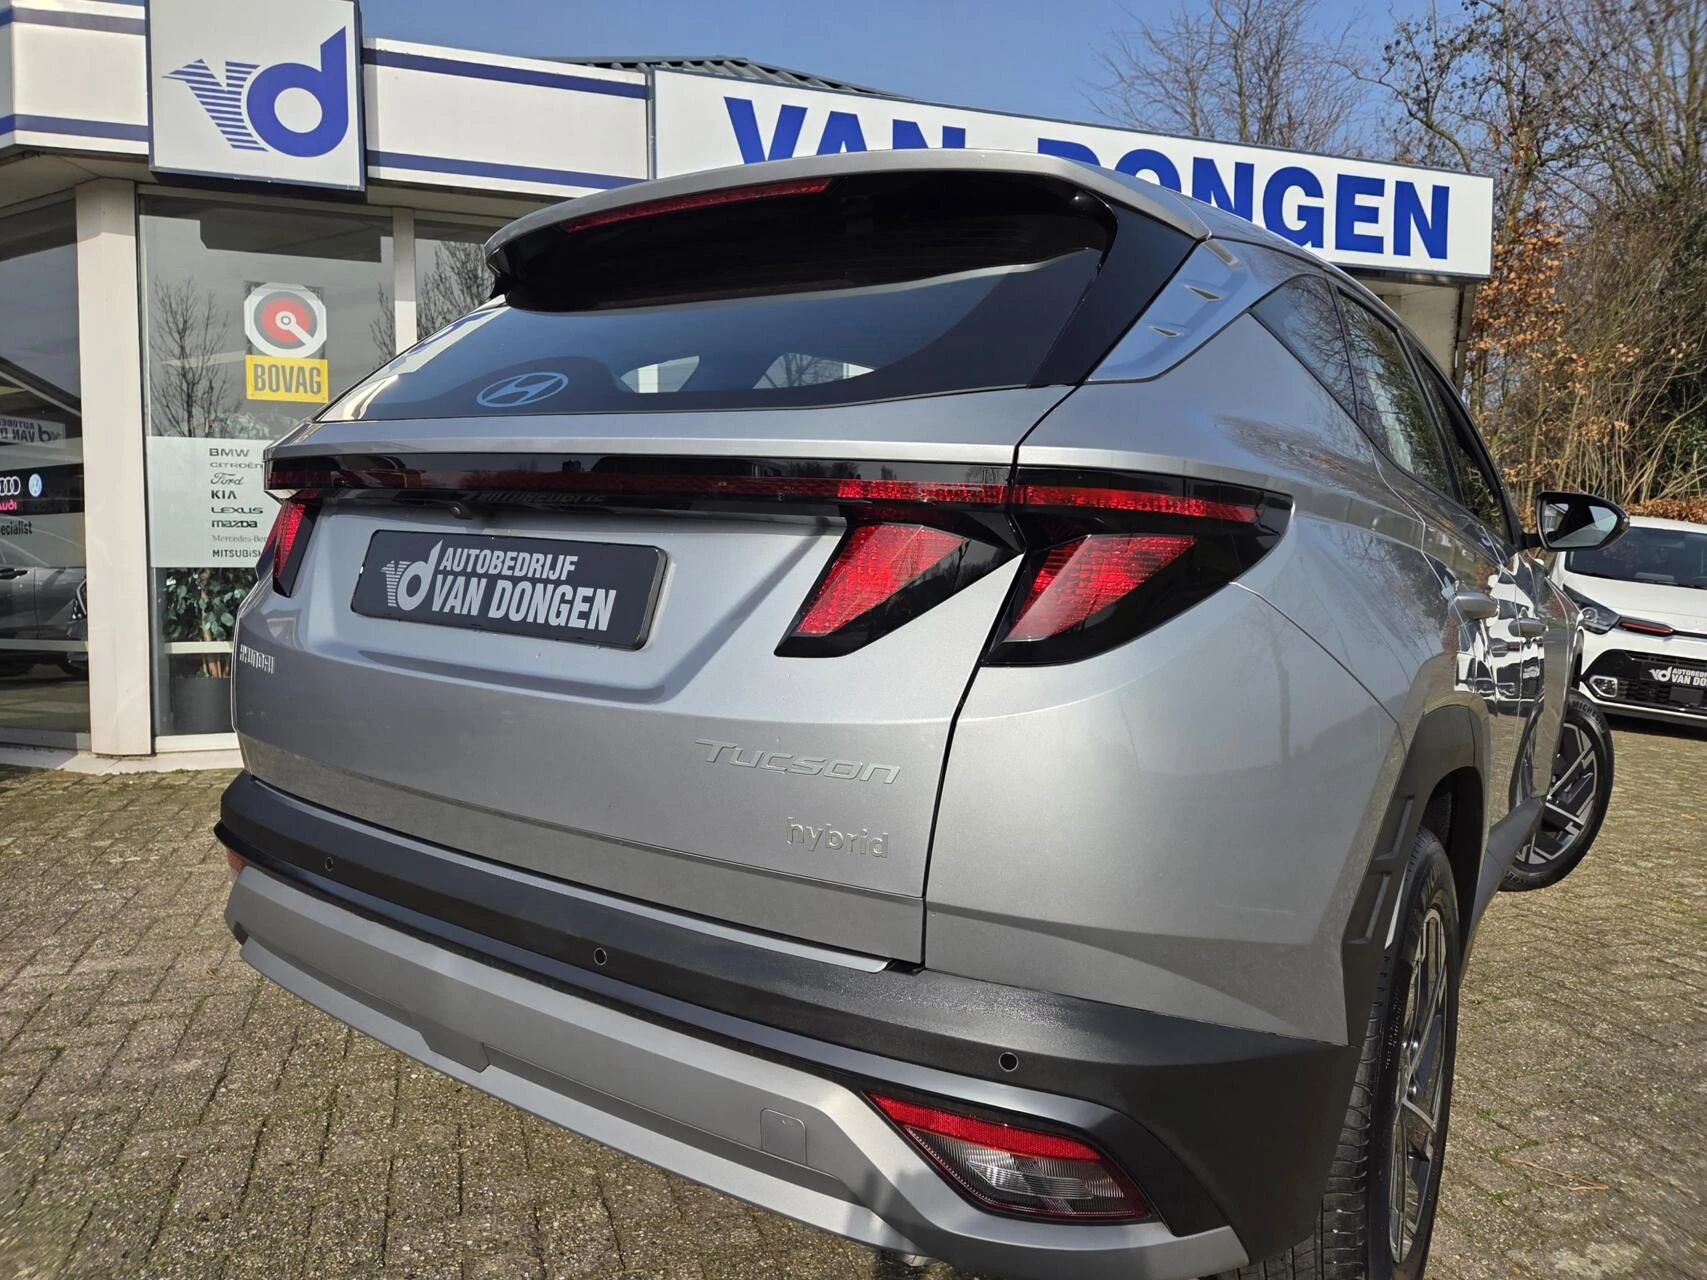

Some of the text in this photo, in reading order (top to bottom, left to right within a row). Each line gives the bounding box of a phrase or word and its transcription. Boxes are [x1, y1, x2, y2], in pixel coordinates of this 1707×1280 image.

[1037, 138, 1450, 260] NGEN
[253, 363, 322, 395] BOVAG
[209, 448, 249, 457] BMW
[210, 472, 244, 486] Ford
[211, 490, 237, 500] KIA
[211, 506, 264, 515] LEXUS
[0, 520, 32, 536] ecialist
[212, 534, 267, 543] Mercedes-Be
[212, 549, 260, 559] MITSUBIS
[442, 547, 578, 581] AUTOBEDRIJF
[432, 575, 617, 631] VAN DONGEN
[1672, 674, 1691, 685] VAN
[786, 816, 889, 858] hybrid
